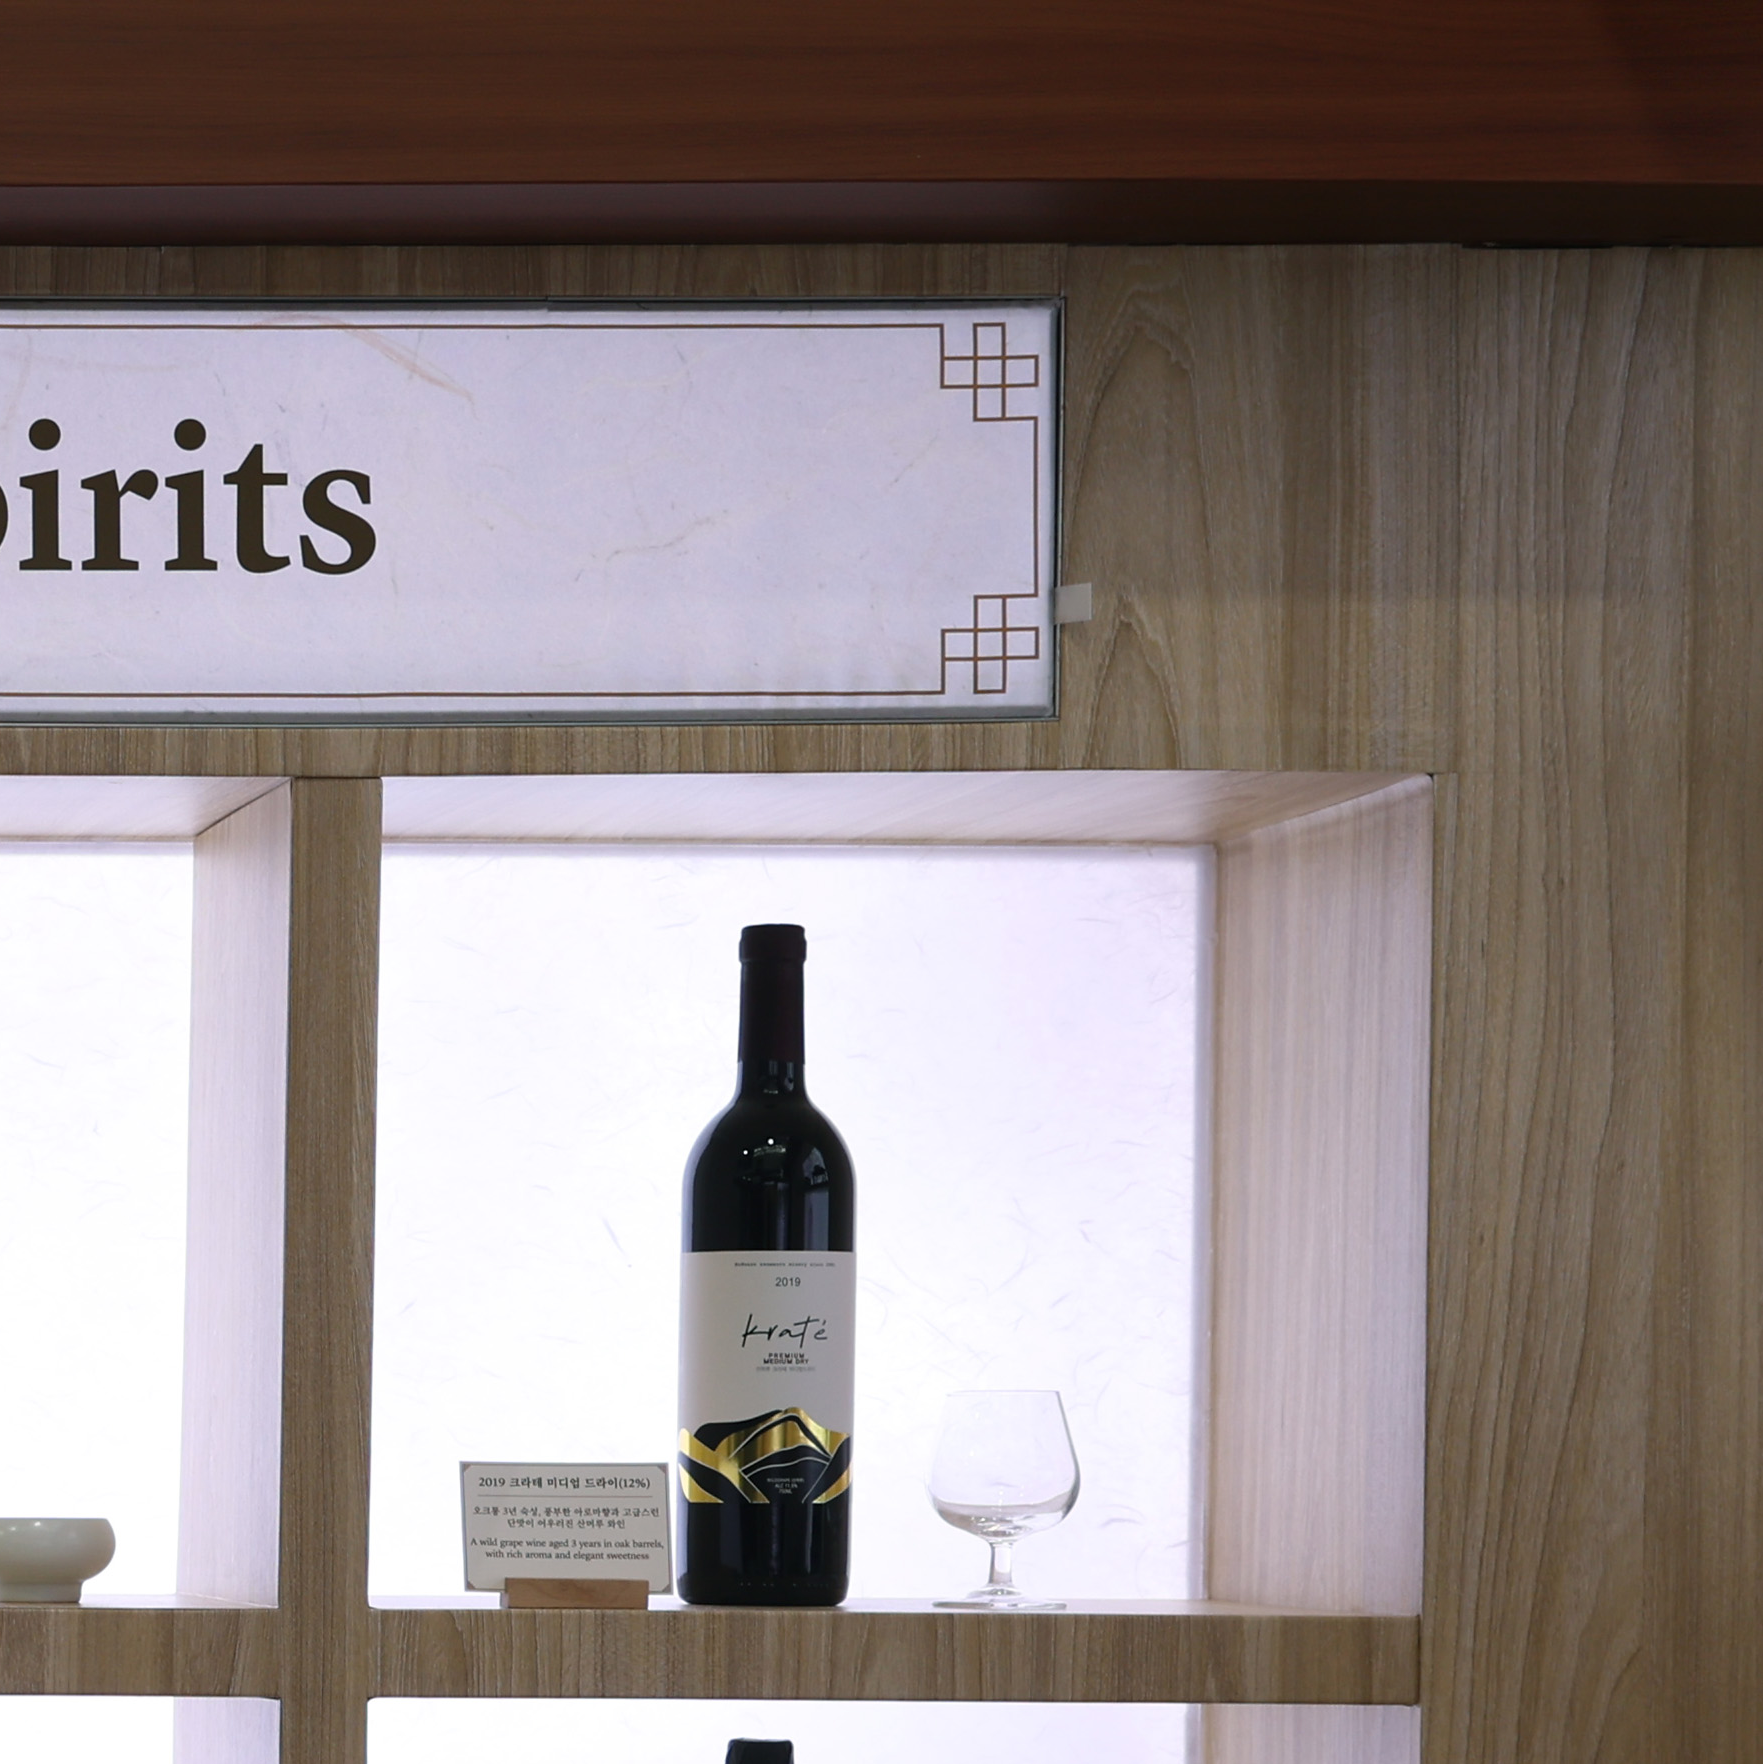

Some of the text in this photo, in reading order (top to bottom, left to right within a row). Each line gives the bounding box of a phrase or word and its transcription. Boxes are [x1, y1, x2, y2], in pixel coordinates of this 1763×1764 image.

[775, 1276, 801, 1287] 2019
[478, 1476, 505, 1487] 2019
[509, 1476, 542, 1488] 크라테
[546, 1476, 579, 1489] 미디엄
